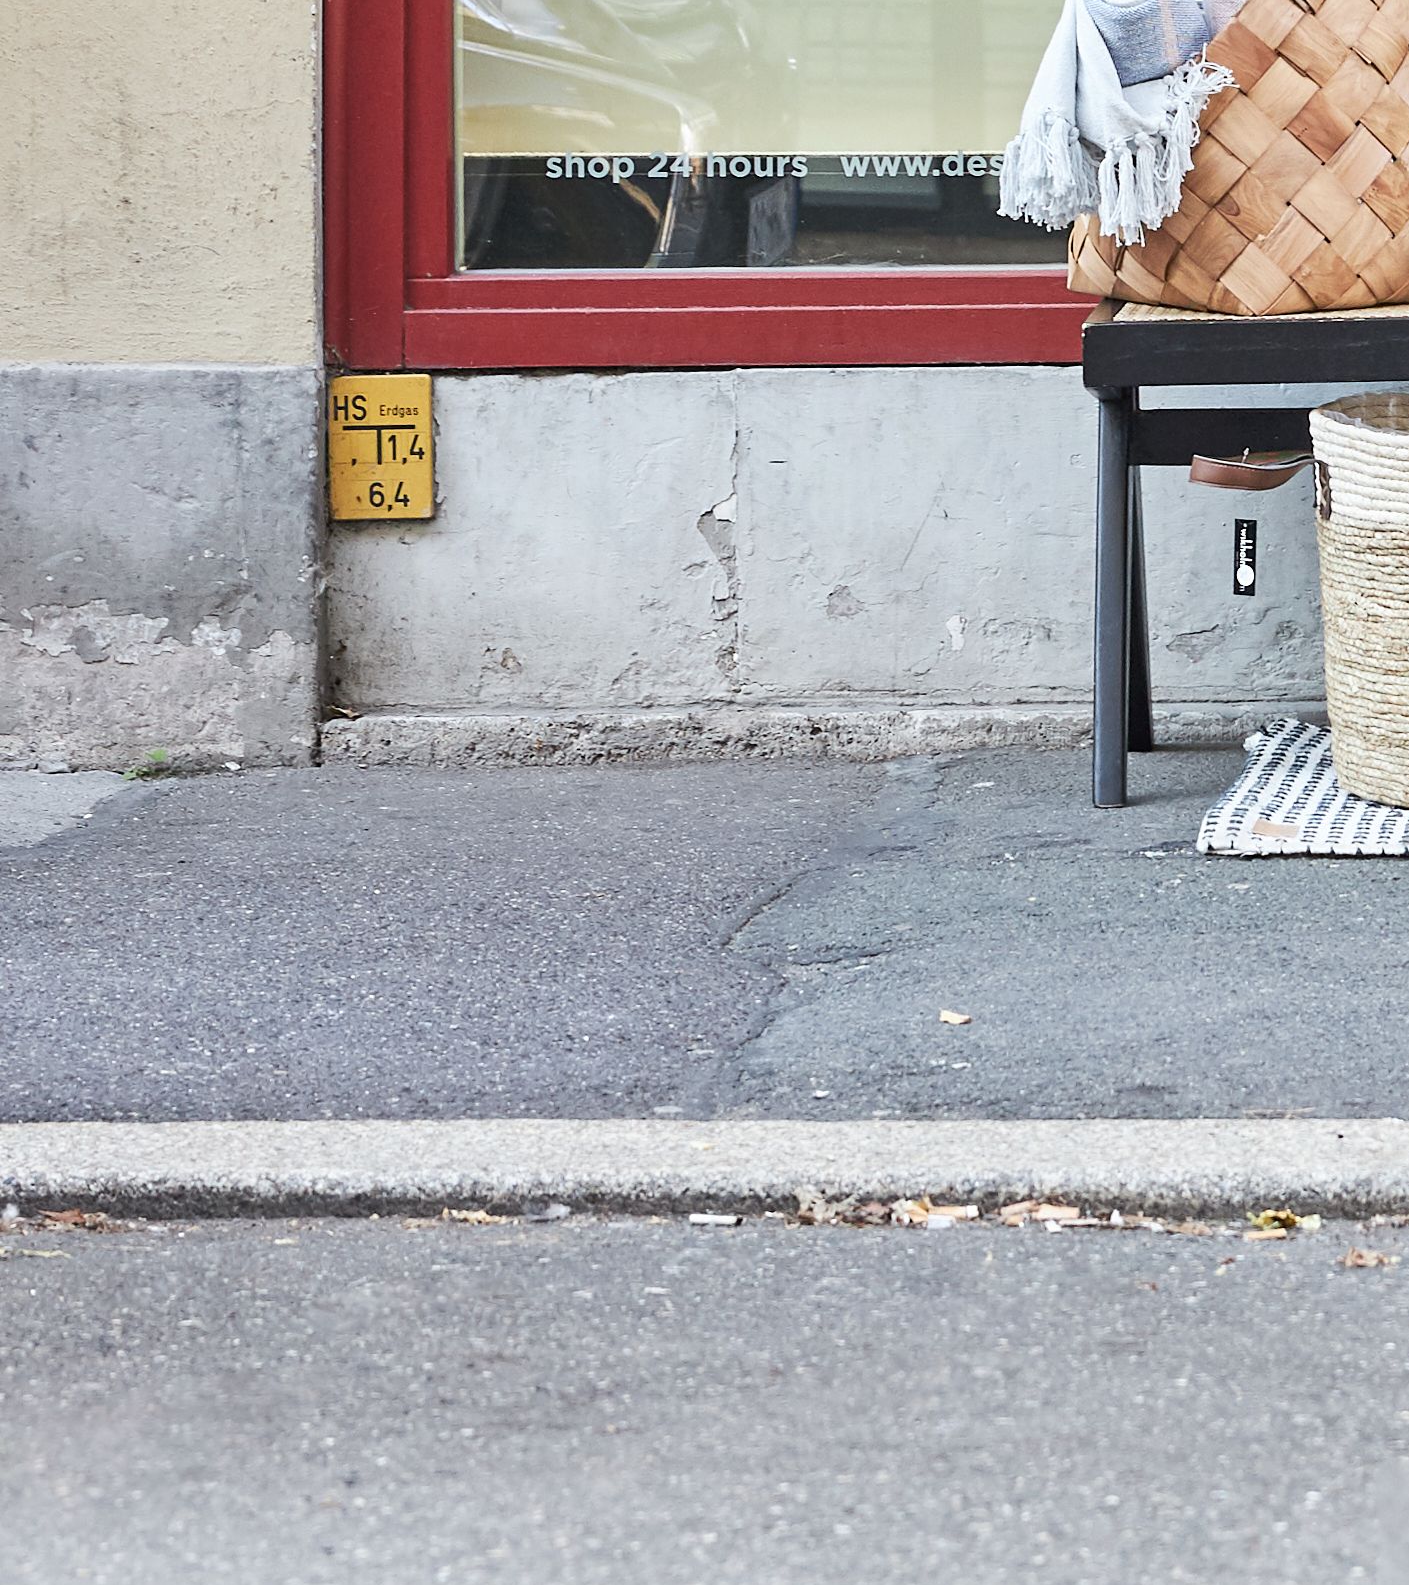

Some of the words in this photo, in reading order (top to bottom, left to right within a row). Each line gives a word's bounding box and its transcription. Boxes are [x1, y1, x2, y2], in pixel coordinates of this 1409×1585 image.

[545, 151, 635, 183] shop
[646, 150, 694, 179] 24
[706, 150, 809, 180] hours
[333, 395, 368, 422] HS
[379, 404, 419, 418] Erdgas
[387, 434, 425, 466] 1,4
[368, 481, 410, 512] 6,4
